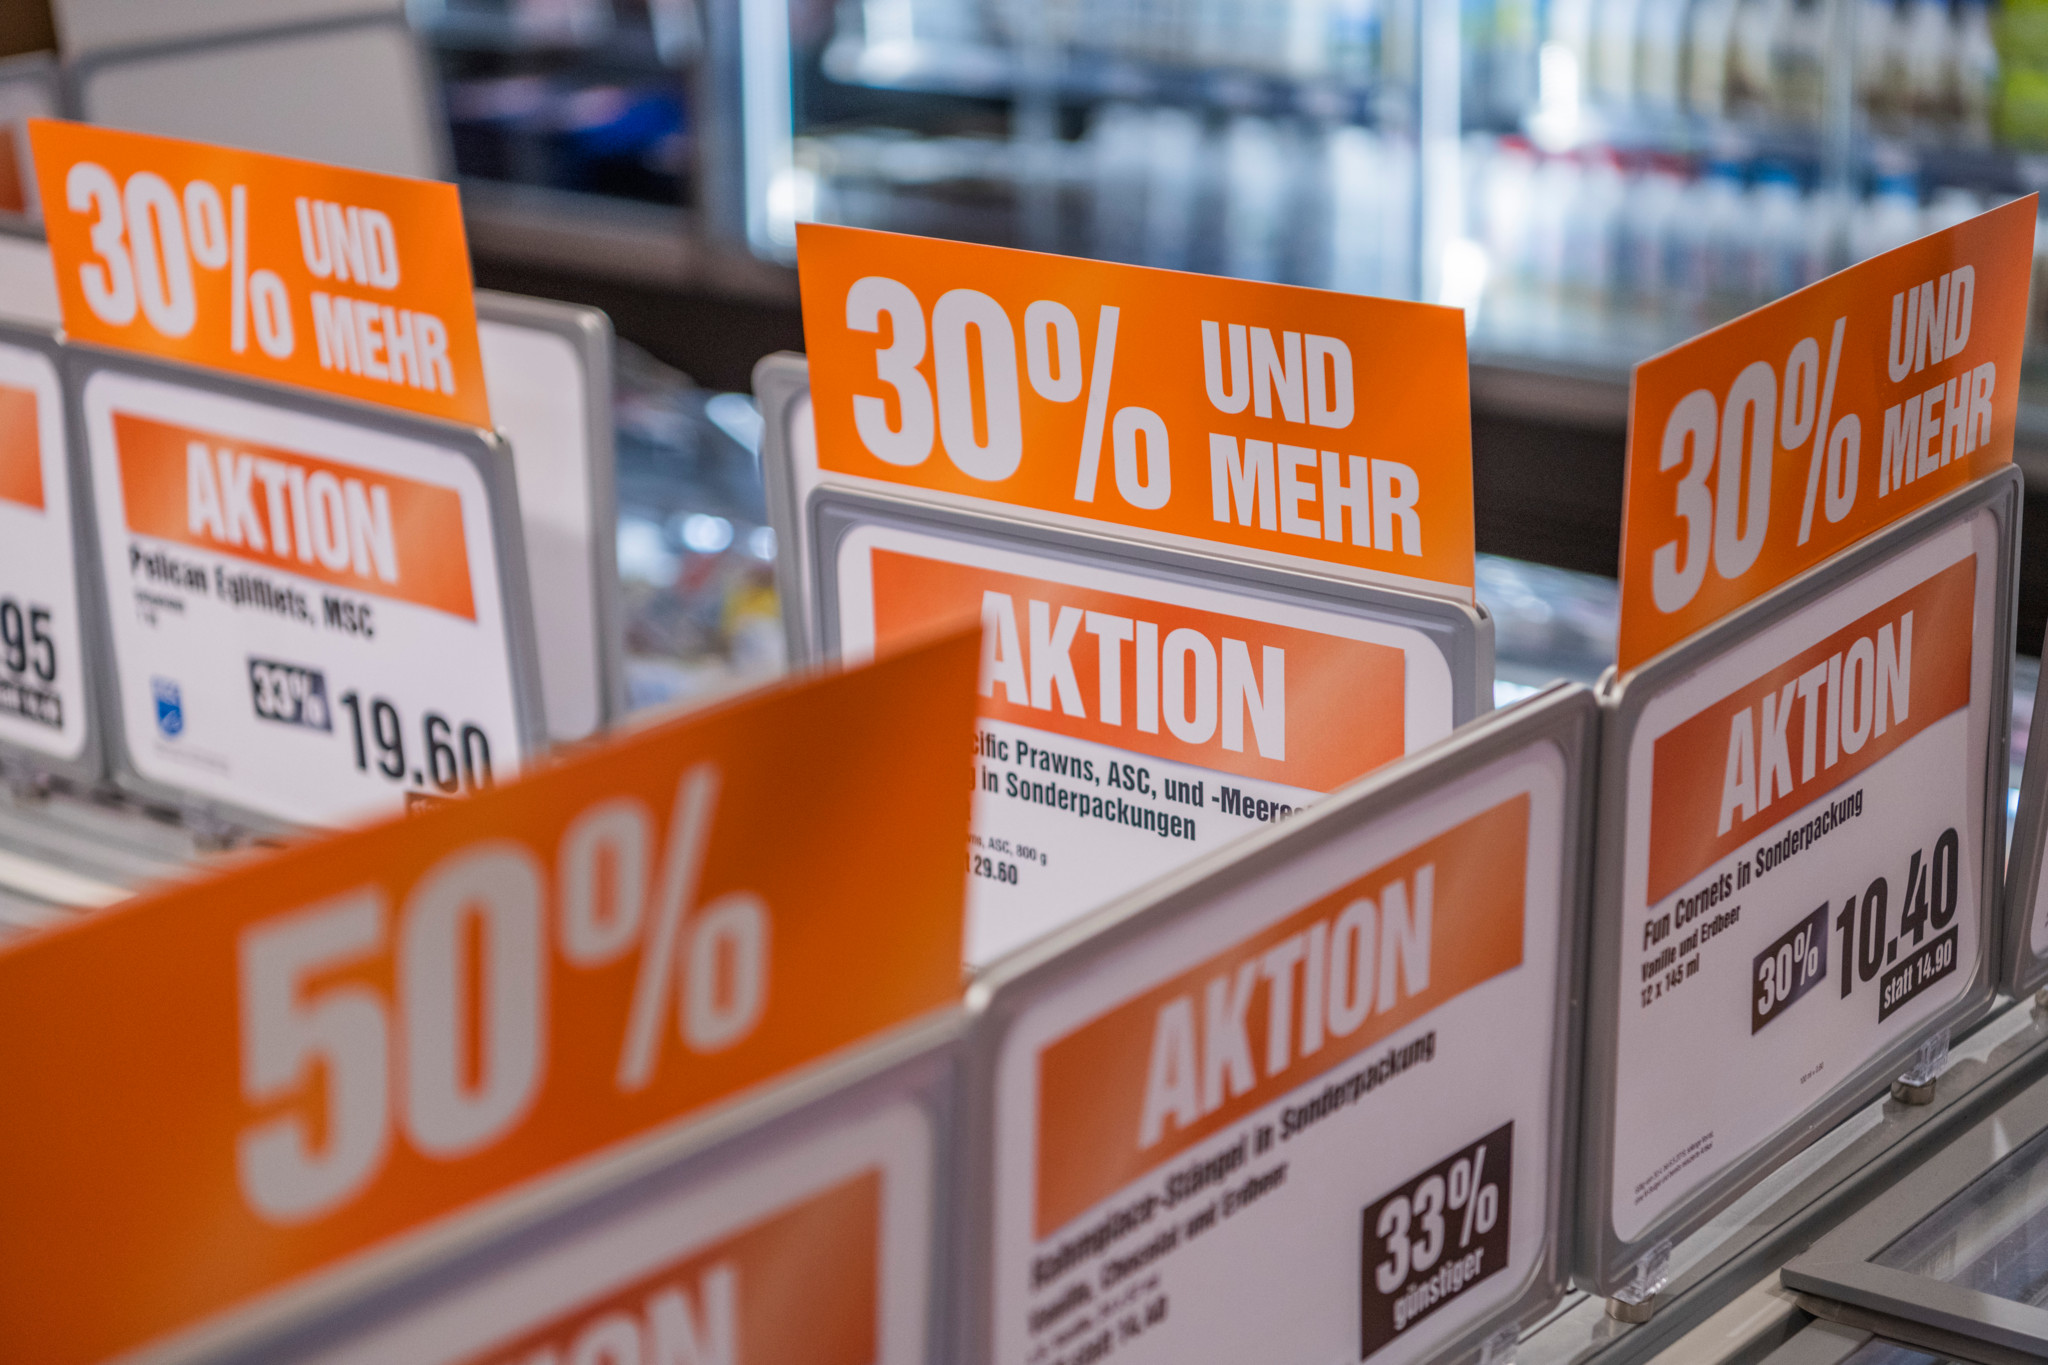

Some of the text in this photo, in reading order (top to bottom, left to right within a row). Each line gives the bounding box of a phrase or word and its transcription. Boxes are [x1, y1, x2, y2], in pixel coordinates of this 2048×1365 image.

[66, 161, 294, 359] 30%
[295, 197, 399, 290] UND
[311, 291, 455, 396] MEHR
[1201, 320, 1354, 429] UND
[1888, 265, 1975, 383] UND
[846, 276, 1171, 509] 30%
[1879, 361, 1996, 498] MEHR
[186, 441, 397, 584] AKTION
[1209, 432, 1422, 557] MEHR
[1652, 316, 1861, 614] 30%
[979, 590, 1285, 762] AKTION
[1716, 610, 1914, 838] AKTION
[339, 690, 494, 794] 19.60
[1016, 739, 1099, 787] Prawns,
[1107, 760, 1157, 800] ASC,
[1164, 777, 1204, 808] und
[982, 766, 999, 793] in
[1006, 771, 1197, 842] Sonderpackungen
[974, 854, 1018, 885] 29.60
[1643, 788, 1863, 951] Fun Cornets in Sonderpackung
[1836, 827, 1959, 1000] 10.40
[238, 764, 769, 1226] 50%
[1641, 905, 1741, 982] Vanille und Erdbeer
[1686, 952, 1700, 978] ml
[1758, 923, 1819, 1015] 30%
[1883, 938, 1953, 1009] statt 14.90
[1138, 863, 1434, 1151] AKTION
[1279, 1030, 1437, 1141] Sonderpackung
[1375, 1145, 1498, 1294] 33%
[1393, 1246, 1484, 1331] günstiger
